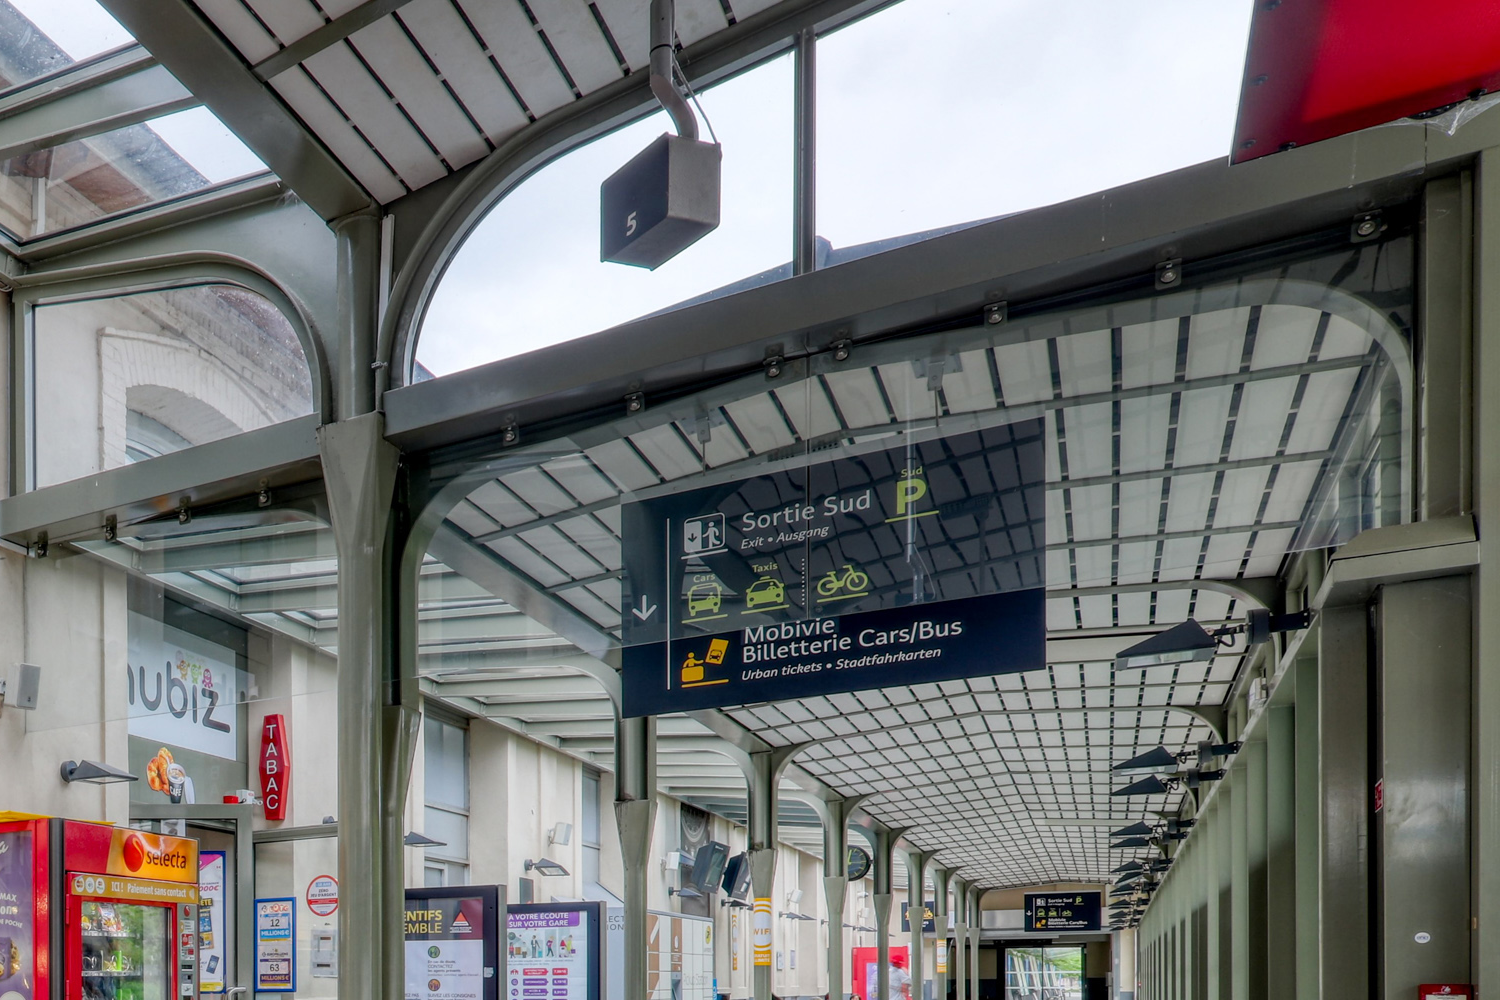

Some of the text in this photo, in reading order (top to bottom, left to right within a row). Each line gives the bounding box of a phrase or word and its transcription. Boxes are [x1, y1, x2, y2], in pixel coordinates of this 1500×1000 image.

[626, 211, 637, 236] 5
[901, 466, 923, 478] Sud
[896, 478, 927, 515] P
[742, 489, 872, 532] Sortie Sud
[741, 524, 830, 550] Exit Ausgang
[751, 561, 778, 572] Taxis
[693, 571, 716, 583] Cars
[743, 617, 836, 645] Mobivie
[743, 620, 963, 663] Billetterie Cars/Bus
[741, 648, 942, 681] Urban tickets Stadtfahrkarten
[265, 723, 279, 810] TABAC
[146, 850, 187, 869] selecta
[0, 892, 17, 903] MAX
[127, 883, 154, 895] Paiement
[154, 887, 166, 896] sans
[167, 888, 187, 898] contact
[5, 919, 23, 929] POCHE
[270, 918, 280, 927] 12
[548, 919, 569, 927] GARE
[269, 963, 280, 972] 63
